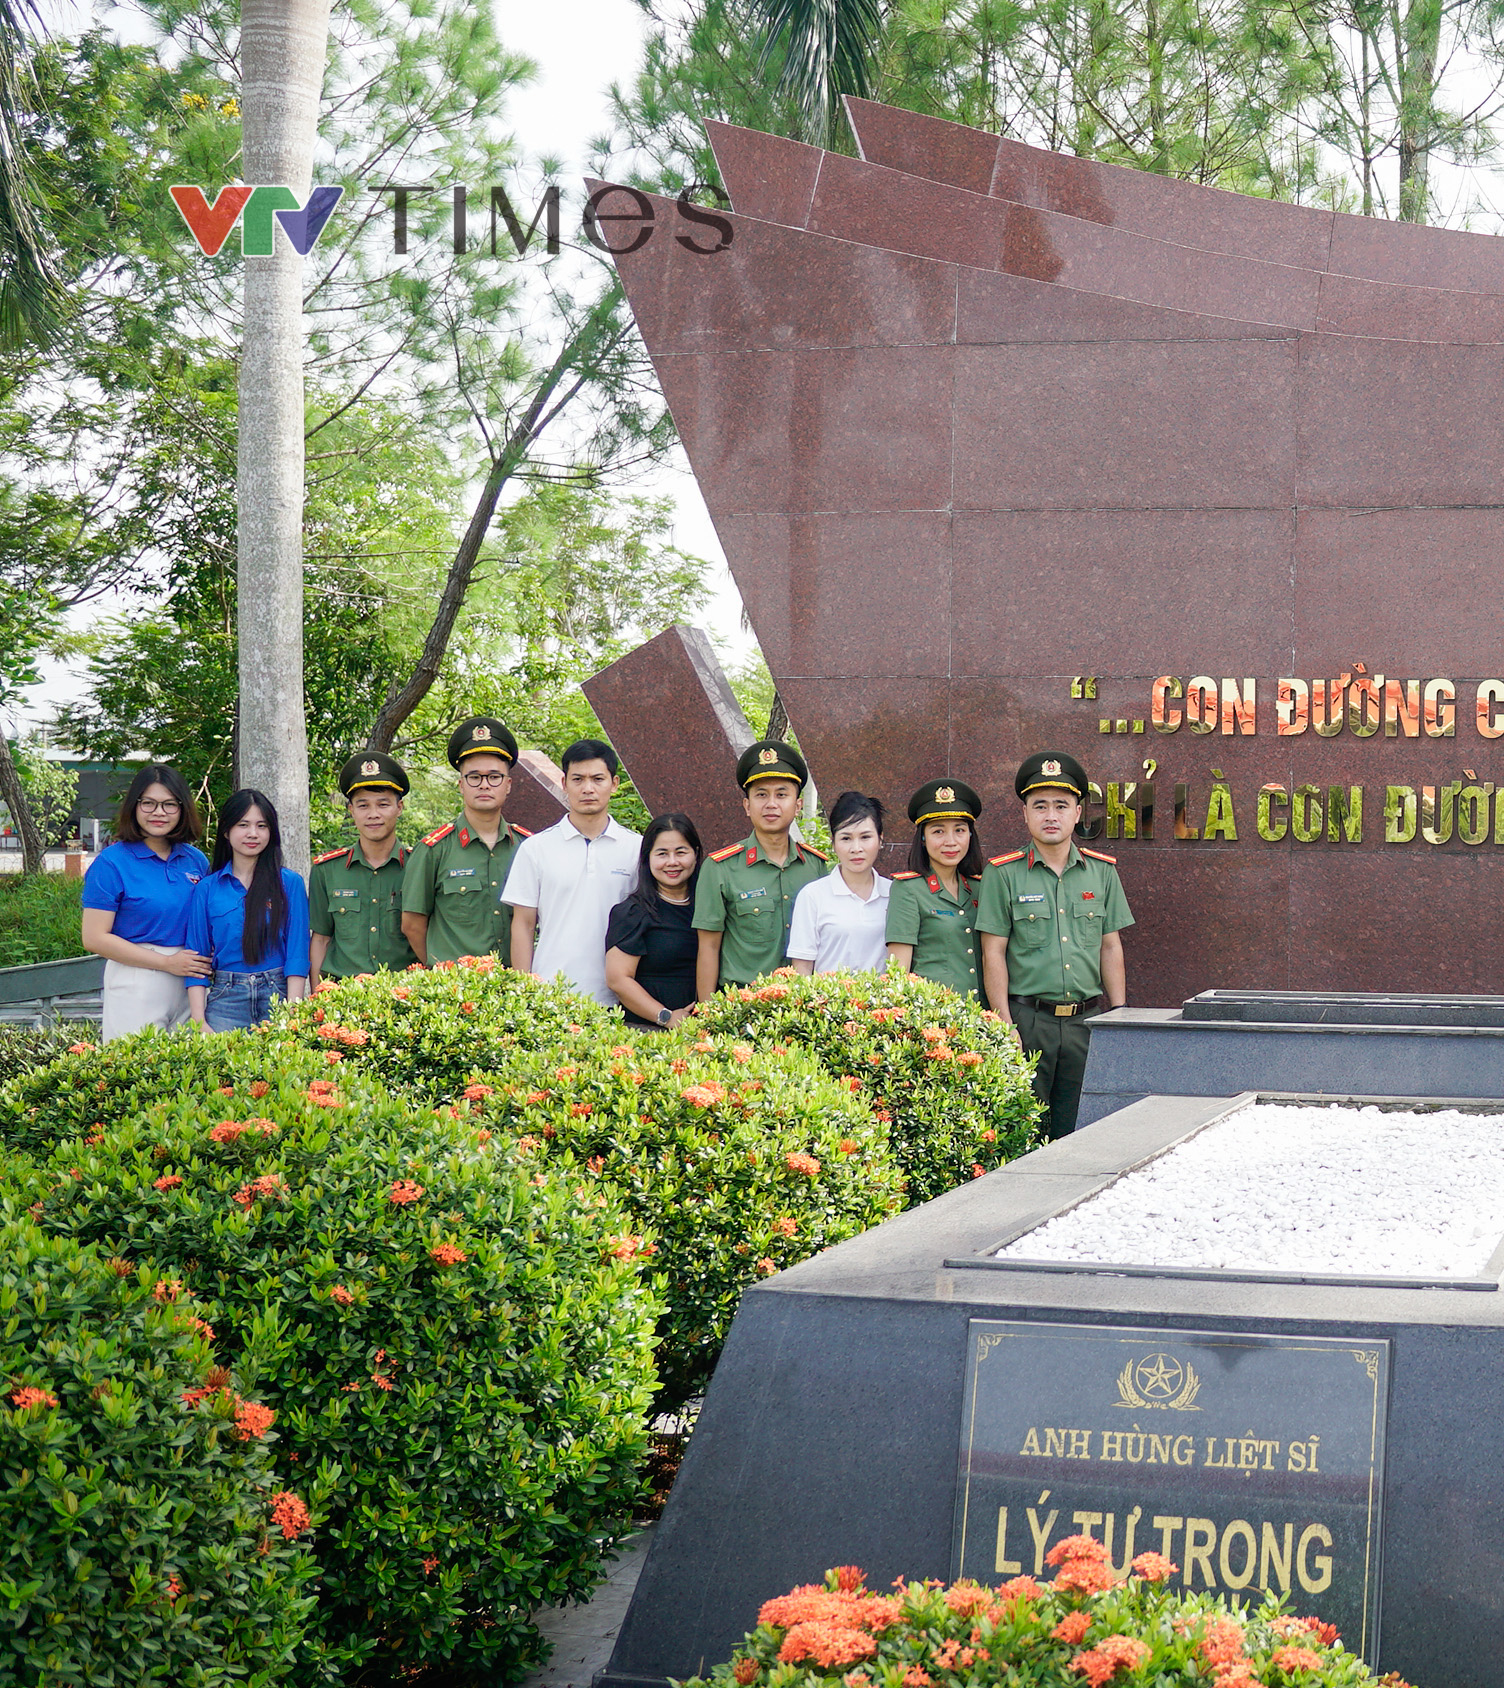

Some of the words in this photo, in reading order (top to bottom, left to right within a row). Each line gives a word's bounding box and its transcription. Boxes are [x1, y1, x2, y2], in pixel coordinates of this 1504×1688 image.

[1275, 662, 1456, 738] ĐƯỜNG
[1075, 758, 1157, 839] CHỈ
[1174, 768, 1239, 841] LÀ
[1256, 782, 1364, 844] CON
[1019, 1426, 1093, 1460] ANH
[1099, 1422, 1196, 1466] HÙNG
[1203, 1428, 1280, 1477] LIỆT
[1287, 1433, 1321, 1472] SĨ
[995, 1489, 1060, 1576] LÝ
